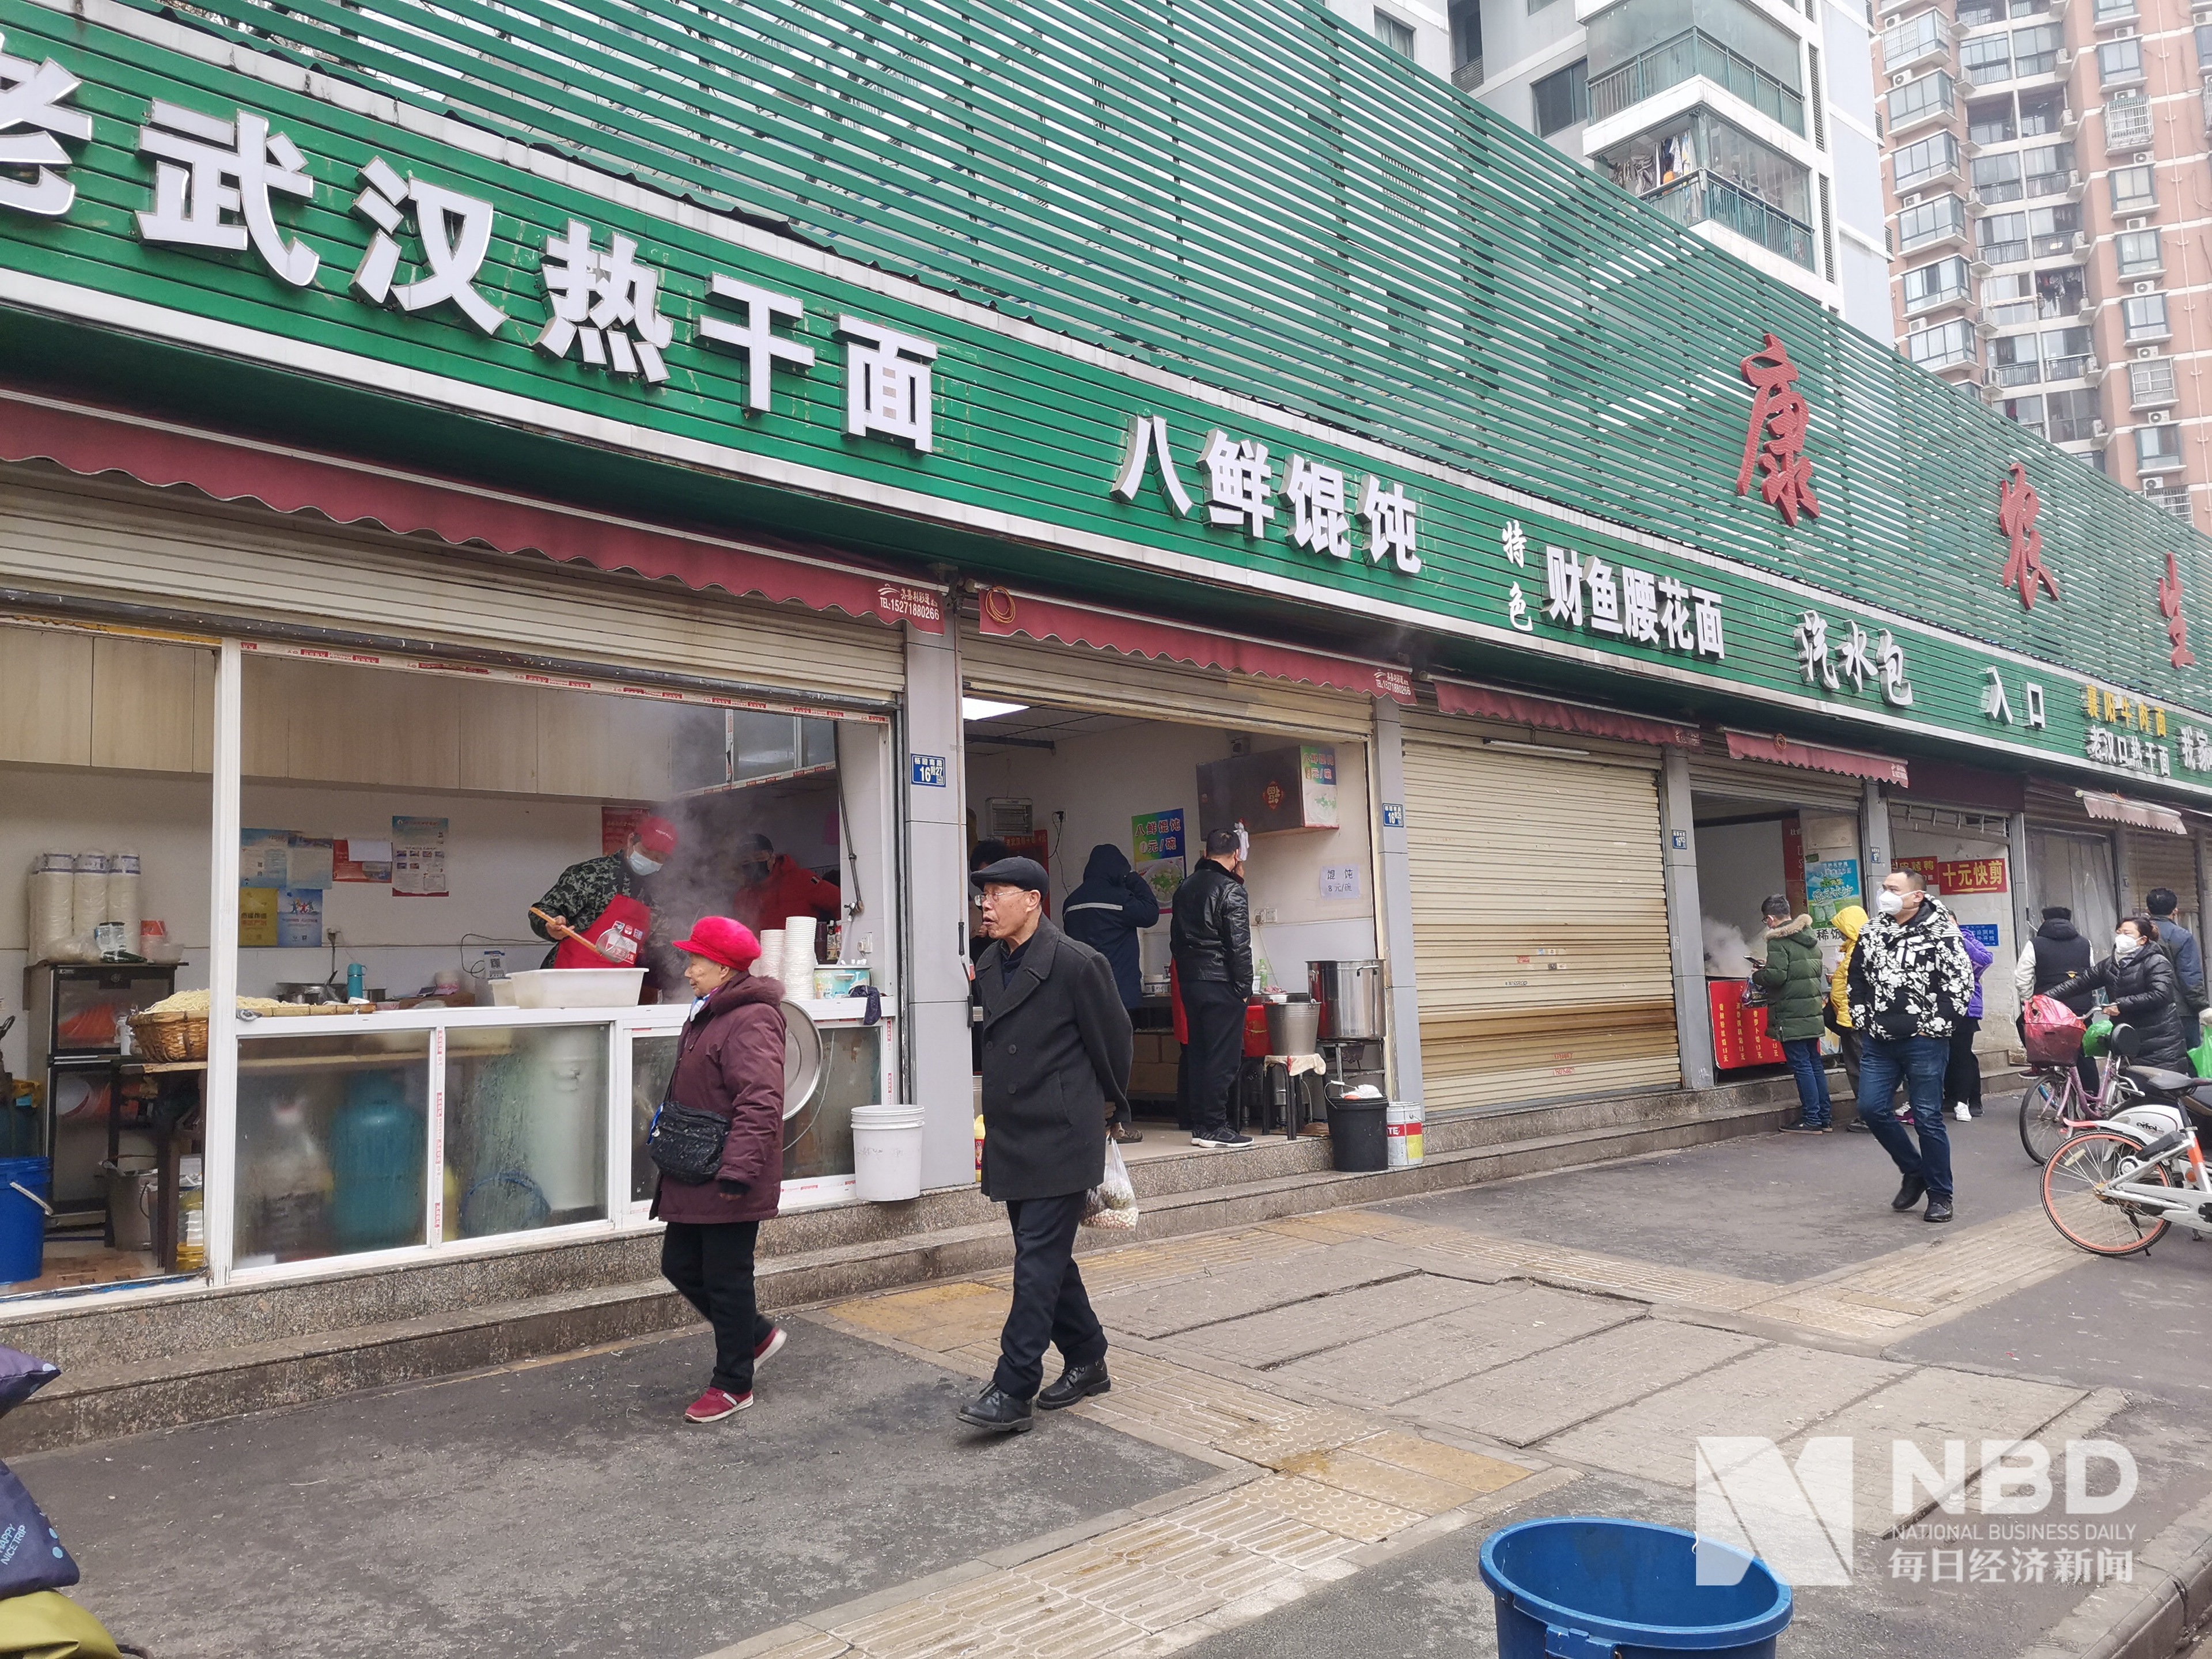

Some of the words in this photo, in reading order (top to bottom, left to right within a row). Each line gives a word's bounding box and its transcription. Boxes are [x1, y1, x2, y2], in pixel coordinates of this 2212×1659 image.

[1111, 414, 1422, 574] 八鲜馄饨
[1501, 520, 1533, 632] 特色
[1543, 545, 1725, 660] 财鱼腰花面
[1984, 666, 2046, 729] 入口
[1135, 818, 1181, 836] 八鲜馄饨
[1942, 860, 2003, 887] 十元快剪
